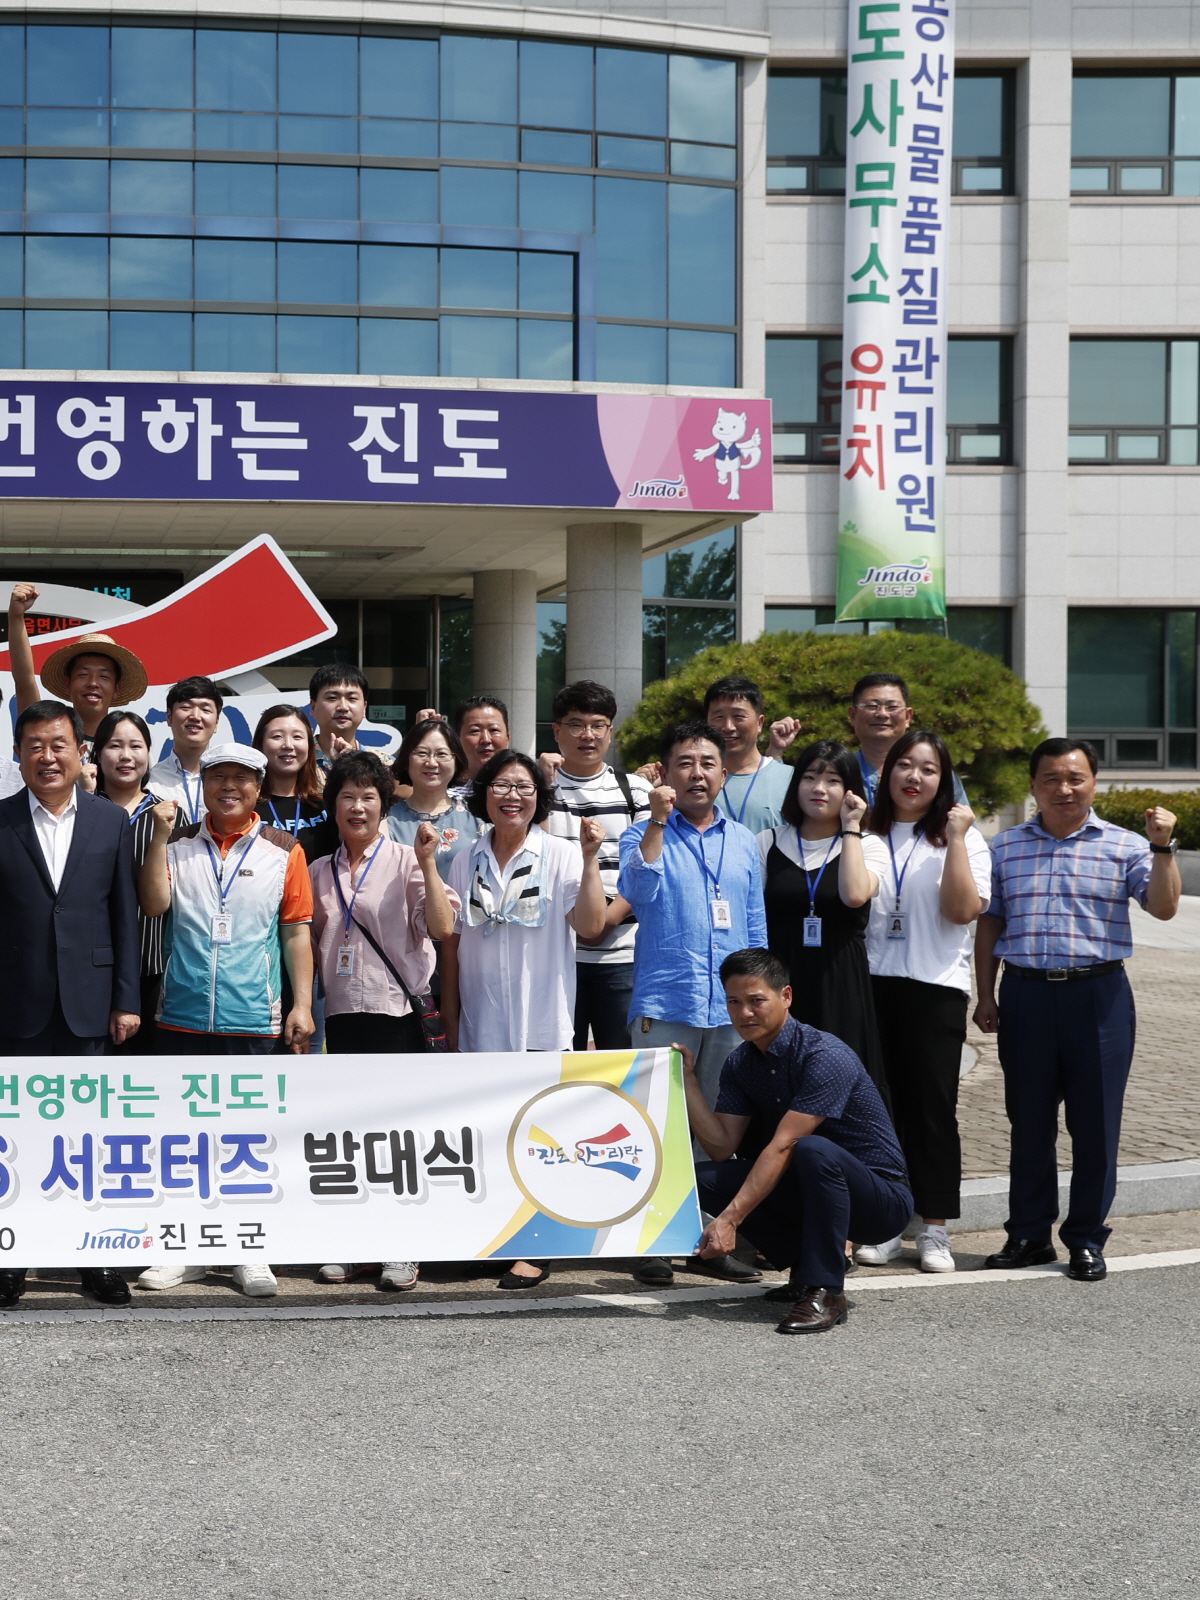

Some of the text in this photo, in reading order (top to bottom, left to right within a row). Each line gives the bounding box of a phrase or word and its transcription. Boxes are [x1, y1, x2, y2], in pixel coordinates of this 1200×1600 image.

[844, 343, 886, 491] 유치
[349, 402, 508, 485] 진도
[628, 481, 678, 497] Jindo
[859, 567, 922, 585] Jindo
[875, 585, 916, 597] 진도군
[23, 617, 93, 634] 읍면사무
[261, 810, 328, 831] AFARI
[239, 869, 254, 877] K2
[182, 1074, 287, 1118] 진도!
[42, 1133, 273, 1201] 서포터즈
[303, 1127, 477, 1197] 발대식
[76, 1231, 141, 1251] Jindo
